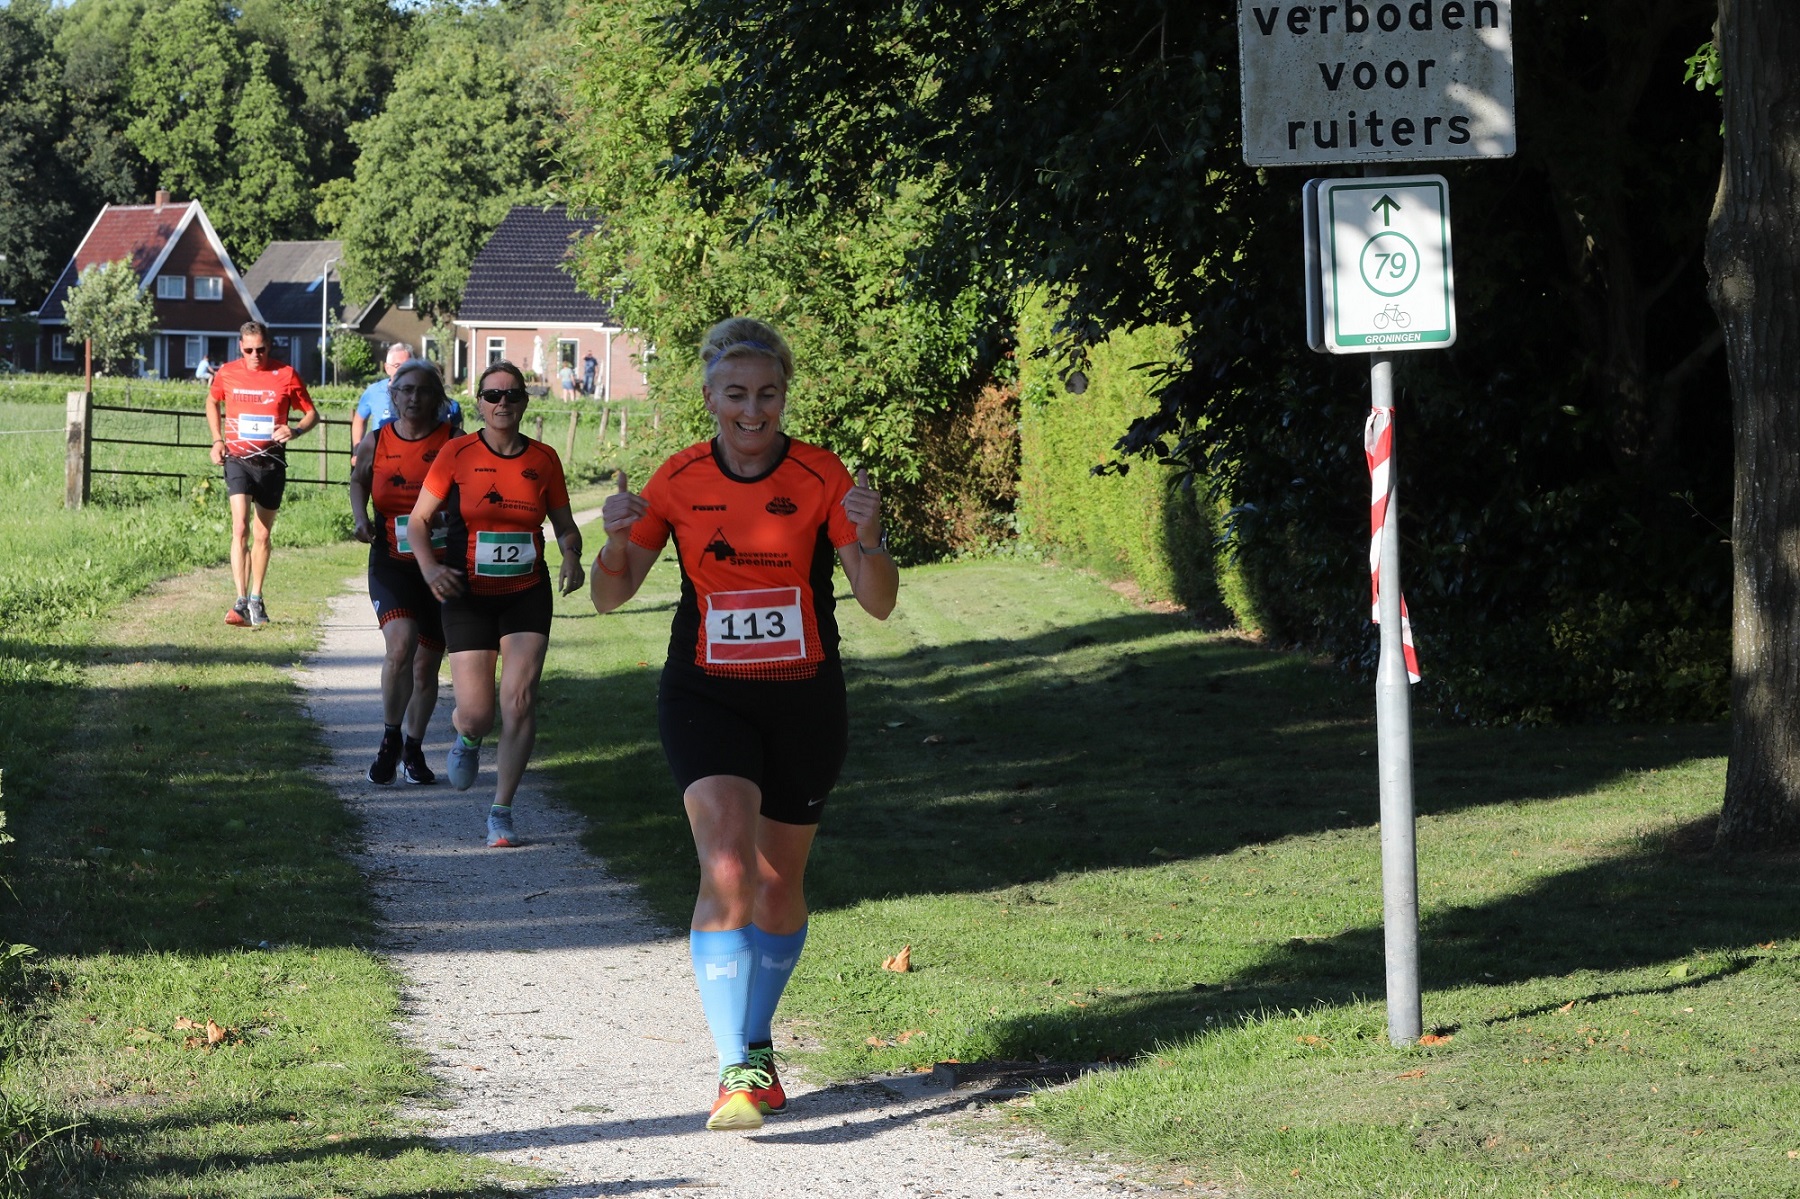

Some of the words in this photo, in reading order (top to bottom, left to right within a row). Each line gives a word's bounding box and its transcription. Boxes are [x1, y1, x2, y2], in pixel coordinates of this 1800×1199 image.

[1252, 0, 1499, 36] verboden
[1318, 59, 1436, 91] voor
[1288, 109, 1471, 150] ruiters
[1374, 252, 1407, 280] 79
[1365, 333, 1421, 344] GRONINGEN
[252, 423, 259, 432] 4
[498, 502, 538, 513] Speelman
[492, 546, 520, 563] 12
[729, 557, 792, 568] Speelman
[721, 611, 787, 641] 113
